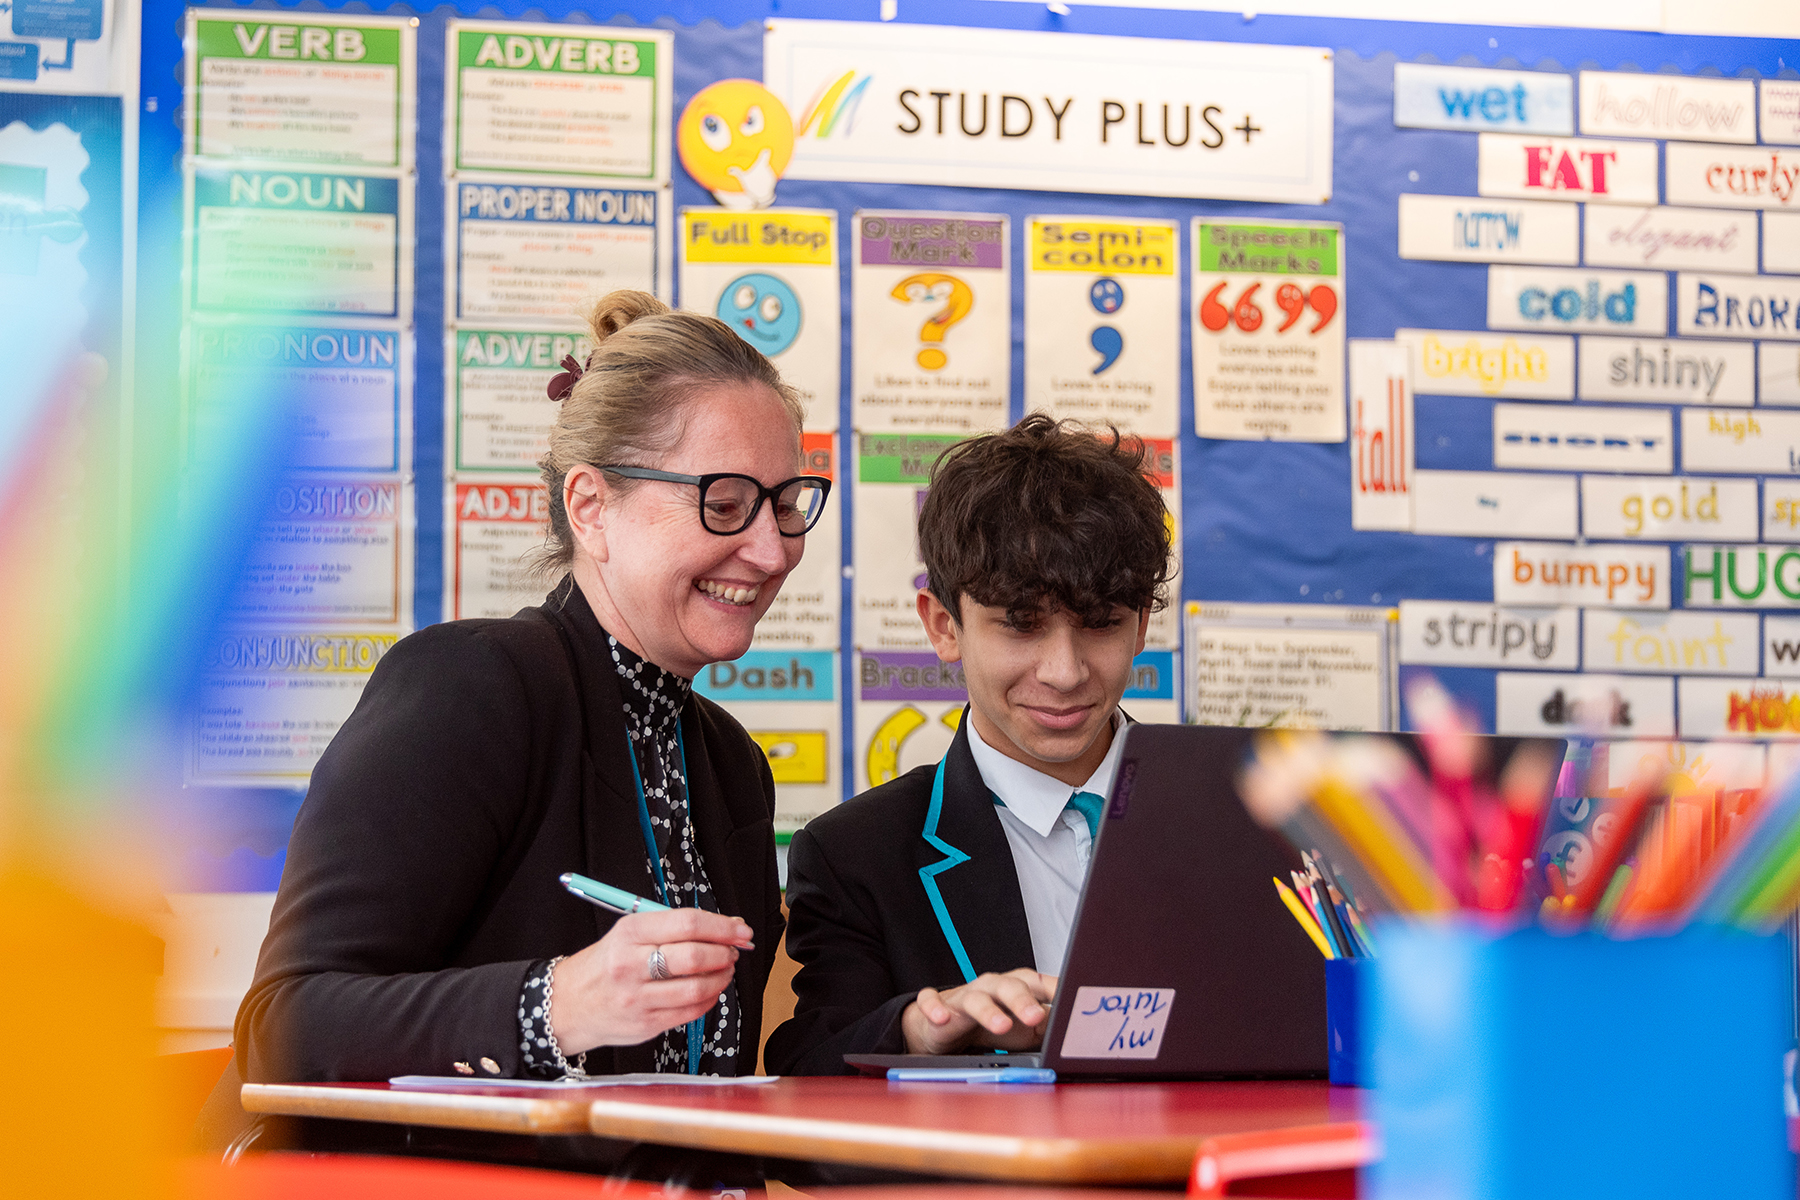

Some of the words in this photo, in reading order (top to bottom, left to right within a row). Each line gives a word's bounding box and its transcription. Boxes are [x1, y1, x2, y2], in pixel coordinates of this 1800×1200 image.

[233, 23, 366, 61] VERB
[475, 34, 640, 74] ADVERB
[898, 89, 1073, 141] STUDY
[1100, 100, 1262, 149] PLUS+
[1438, 81, 1528, 126] wet
[1594, 83, 1744, 135] hollow
[1523, 145, 1617, 195] FAT
[1705, 150, 1800, 205] curly
[230, 174, 366, 211] NOUN
[461, 184, 571, 220] PROPER
[573, 189, 655, 225] NOUN
[690, 220, 751, 246] Full
[761, 222, 829, 252] Stop
[861, 216, 1002, 243] Question
[1041, 224, 1166, 250] Semi-
[1209, 225, 1330, 251] Speech
[1454, 209, 1523, 251] narrow
[1608, 205, 1740, 262] elegant
[890, 241, 979, 263] Mark
[1042, 245, 1163, 269] colon
[1218, 250, 1322, 274] Marks
[1517, 280, 1637, 326] cold
[875, 376, 913, 390] Likes
[916, 377, 932, 389] to
[934, 376, 961, 390] find
[1423, 334, 1550, 394] bright
[1609, 347, 1728, 399] shiny
[1353, 377, 1410, 494] tall
[1708, 410, 1762, 445] high
[1622, 480, 1721, 536] gold
[1513, 550, 1657, 602] bumpy
[1422, 610, 1557, 660] stripy
[1607, 617, 1735, 668] faint
[708, 657, 815, 690] Dash
[861, 656, 968, 690] Bracke
[1081, 990, 1167, 1019] Tutor
[1107, 1015, 1155, 1051] my
